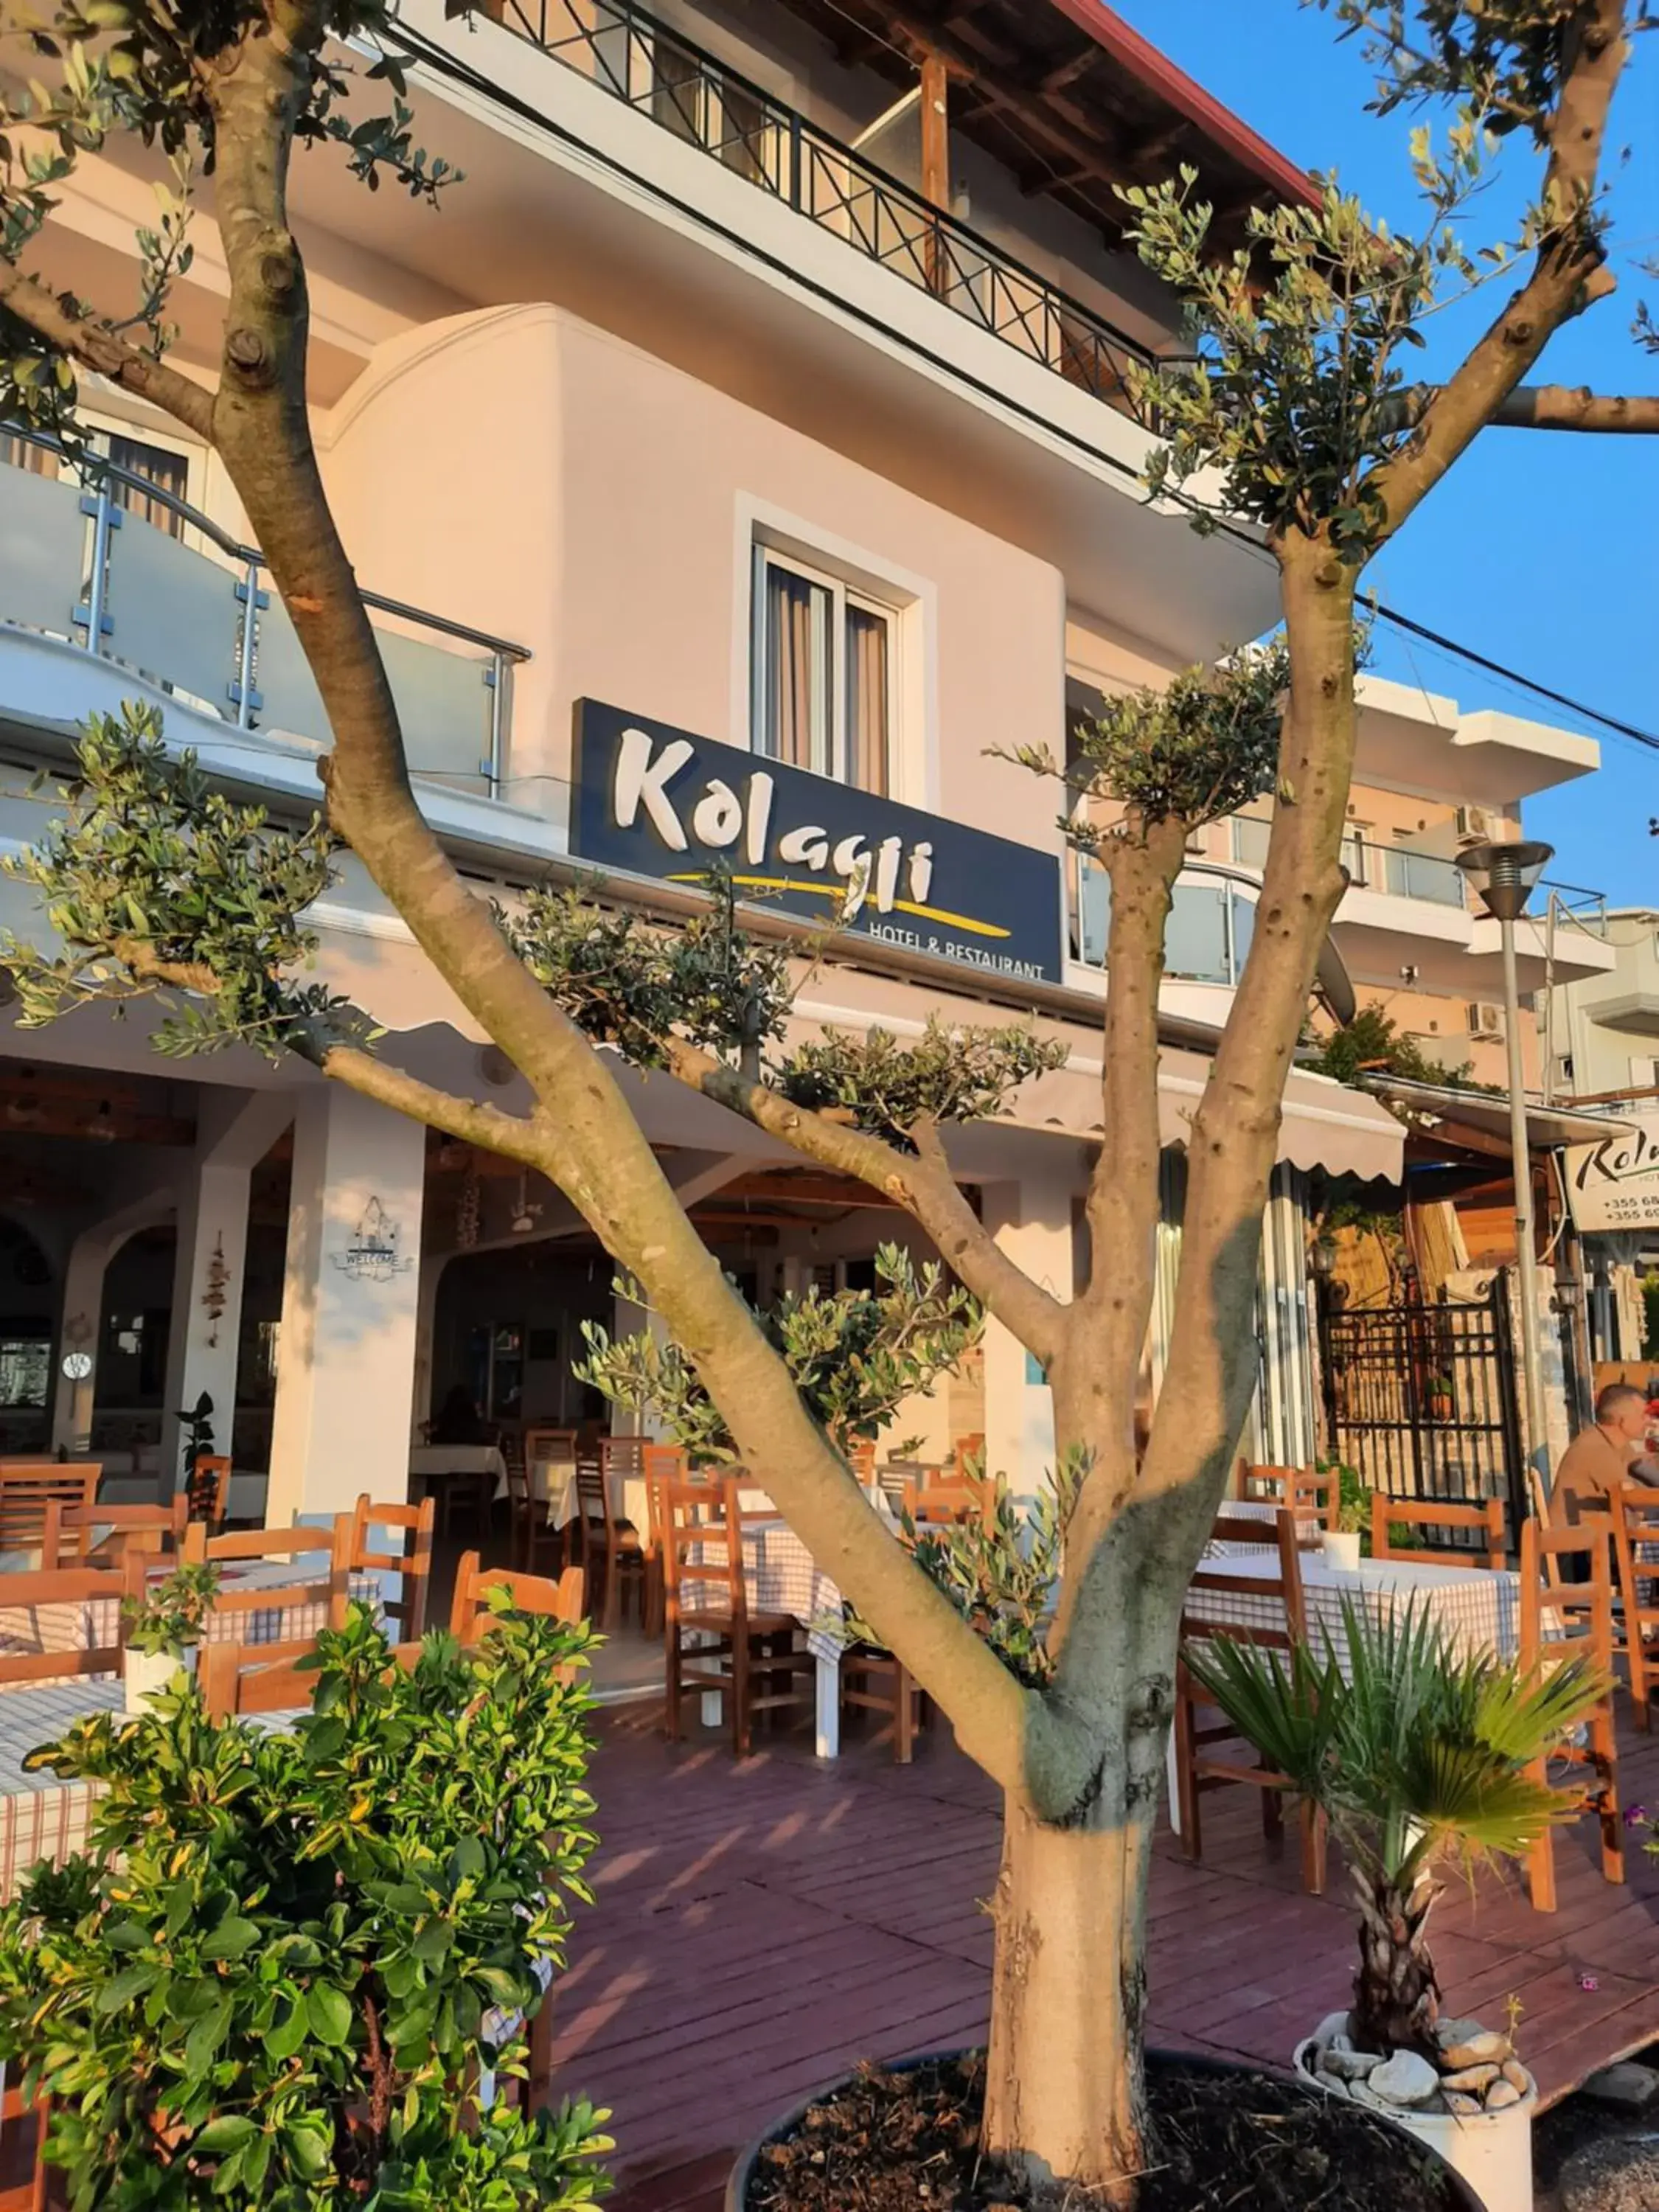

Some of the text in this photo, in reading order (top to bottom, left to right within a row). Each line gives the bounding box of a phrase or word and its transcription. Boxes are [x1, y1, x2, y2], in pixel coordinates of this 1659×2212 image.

[869, 922, 1045, 980] HOTEL & RESTAURANT
[1604, 1197, 1638, 1209] +355
[1607, 1210, 1641, 1221] +355
[346, 1253, 399, 1267] WELCOME
